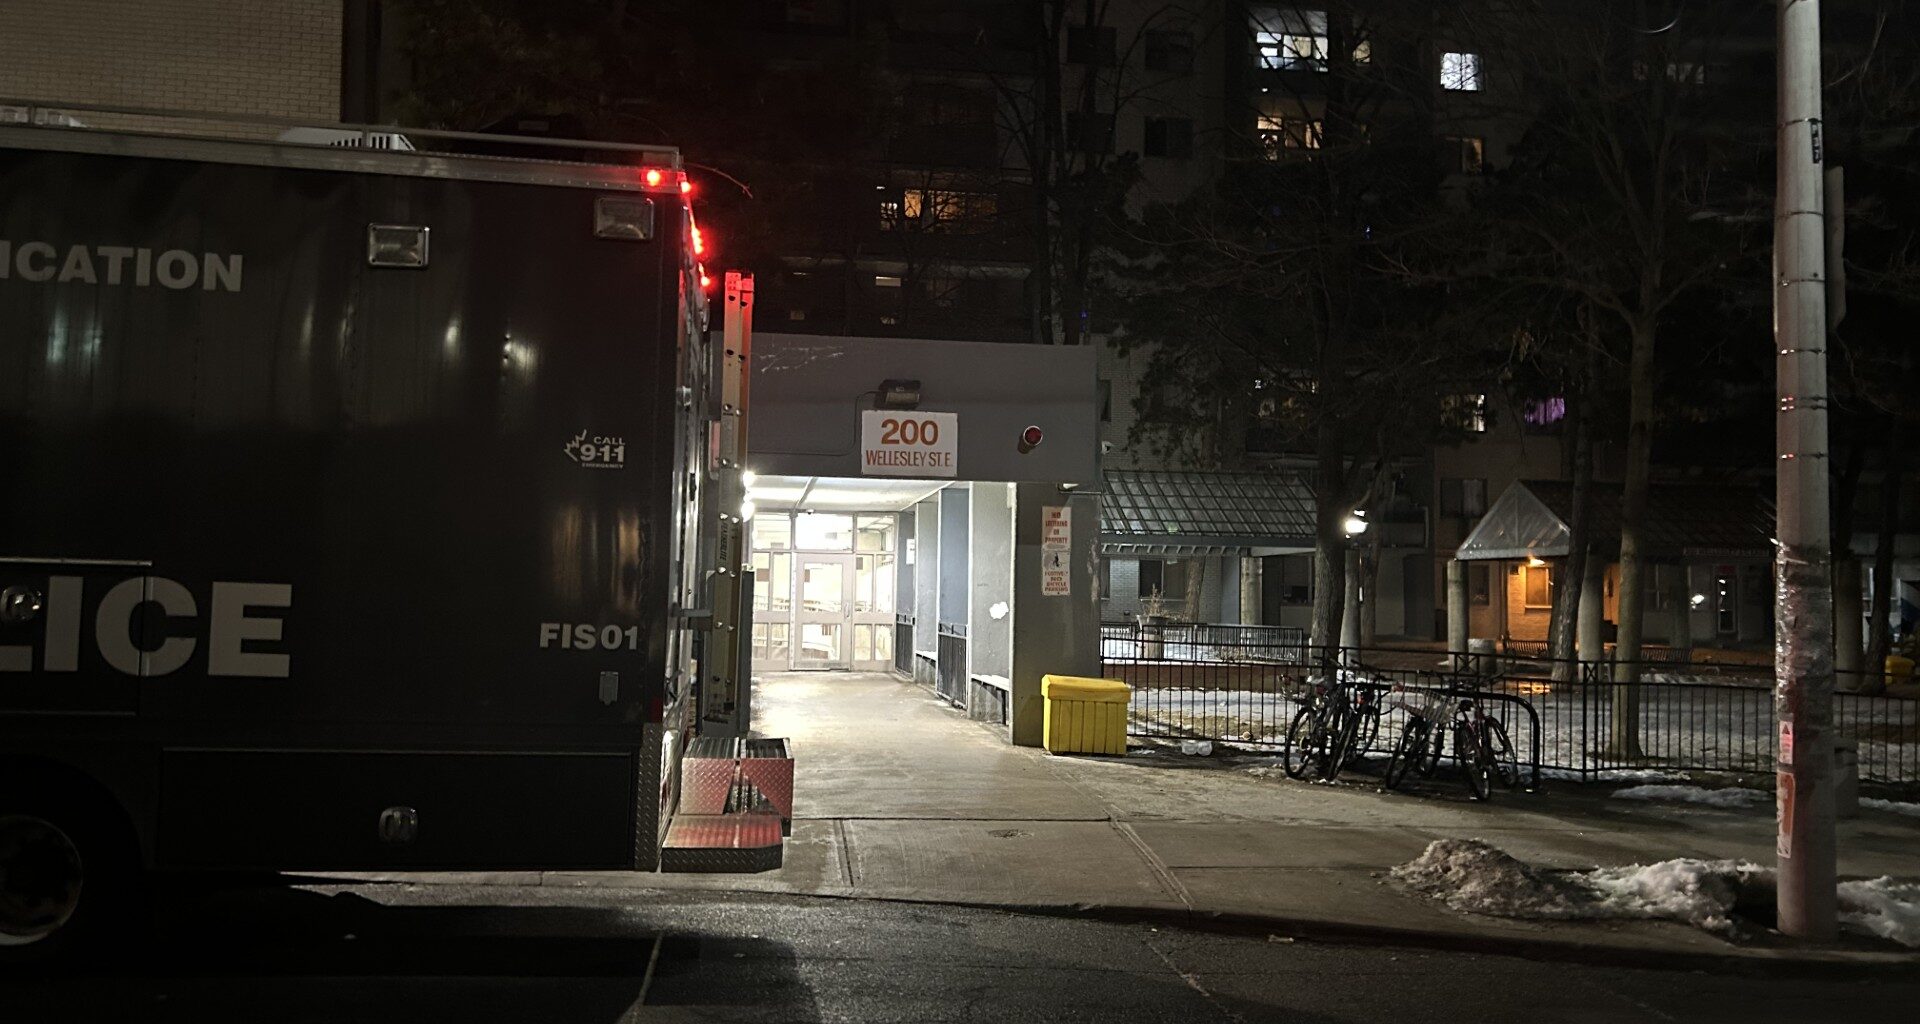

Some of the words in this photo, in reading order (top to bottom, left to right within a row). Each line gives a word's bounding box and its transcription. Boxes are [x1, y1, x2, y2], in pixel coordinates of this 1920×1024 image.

[0, 240, 243, 292] ICATION
[593, 436, 626, 446] CALL
[881, 418, 939, 446] 200
[865, 449, 928, 468] WELLESLEY
